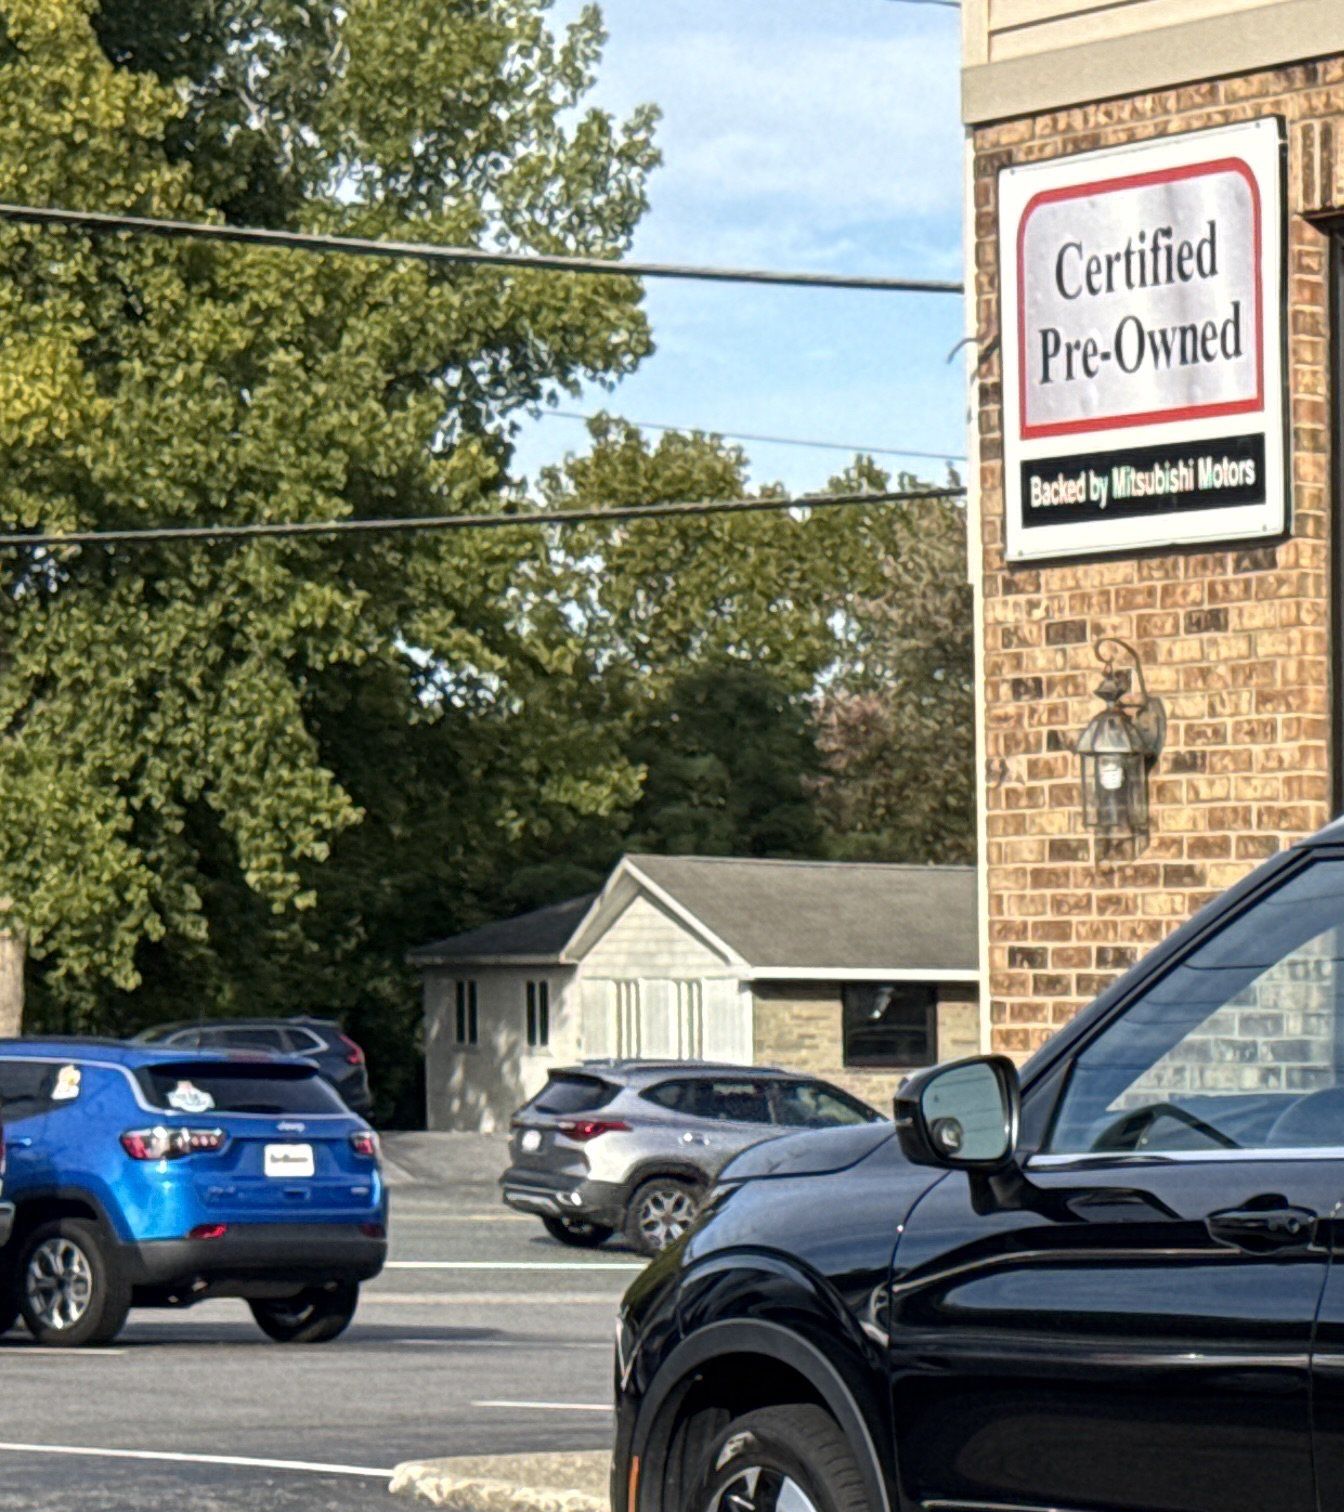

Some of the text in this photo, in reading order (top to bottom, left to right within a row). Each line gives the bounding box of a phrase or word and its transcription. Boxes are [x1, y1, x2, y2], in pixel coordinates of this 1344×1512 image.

[1055, 220, 1218, 300] Certified
[1038, 300, 1243, 384] Pre-Owned
[1030, 456, 1255, 509] Backed by Mitsubishi Motors
